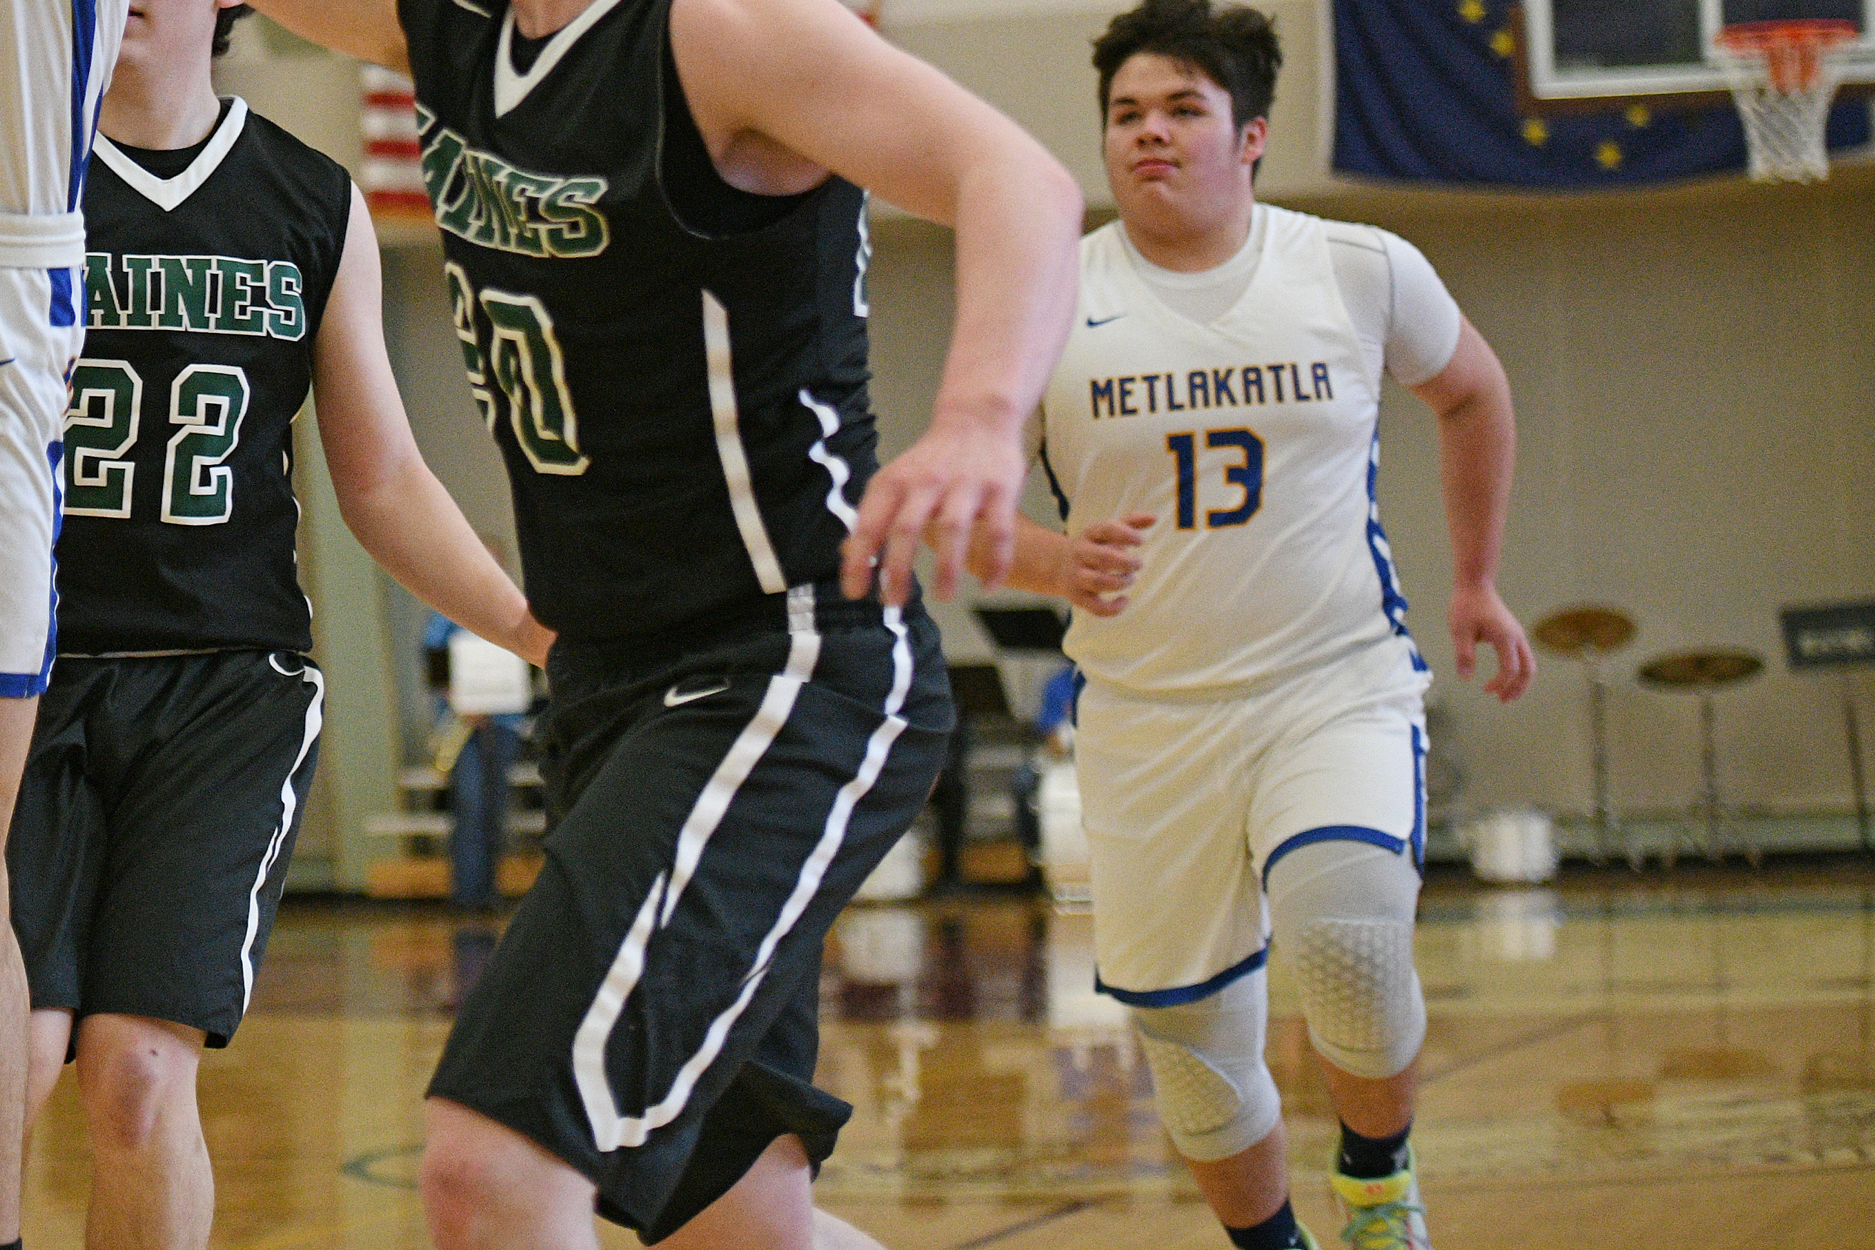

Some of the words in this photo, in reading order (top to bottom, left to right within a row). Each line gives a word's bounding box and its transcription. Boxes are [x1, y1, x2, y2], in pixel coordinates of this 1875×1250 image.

[85, 252, 306, 342] AINES
[1090, 362, 1334, 419] METLAKATLA
[63, 358, 250, 526] 22
[1165, 426, 1266, 531] 13
